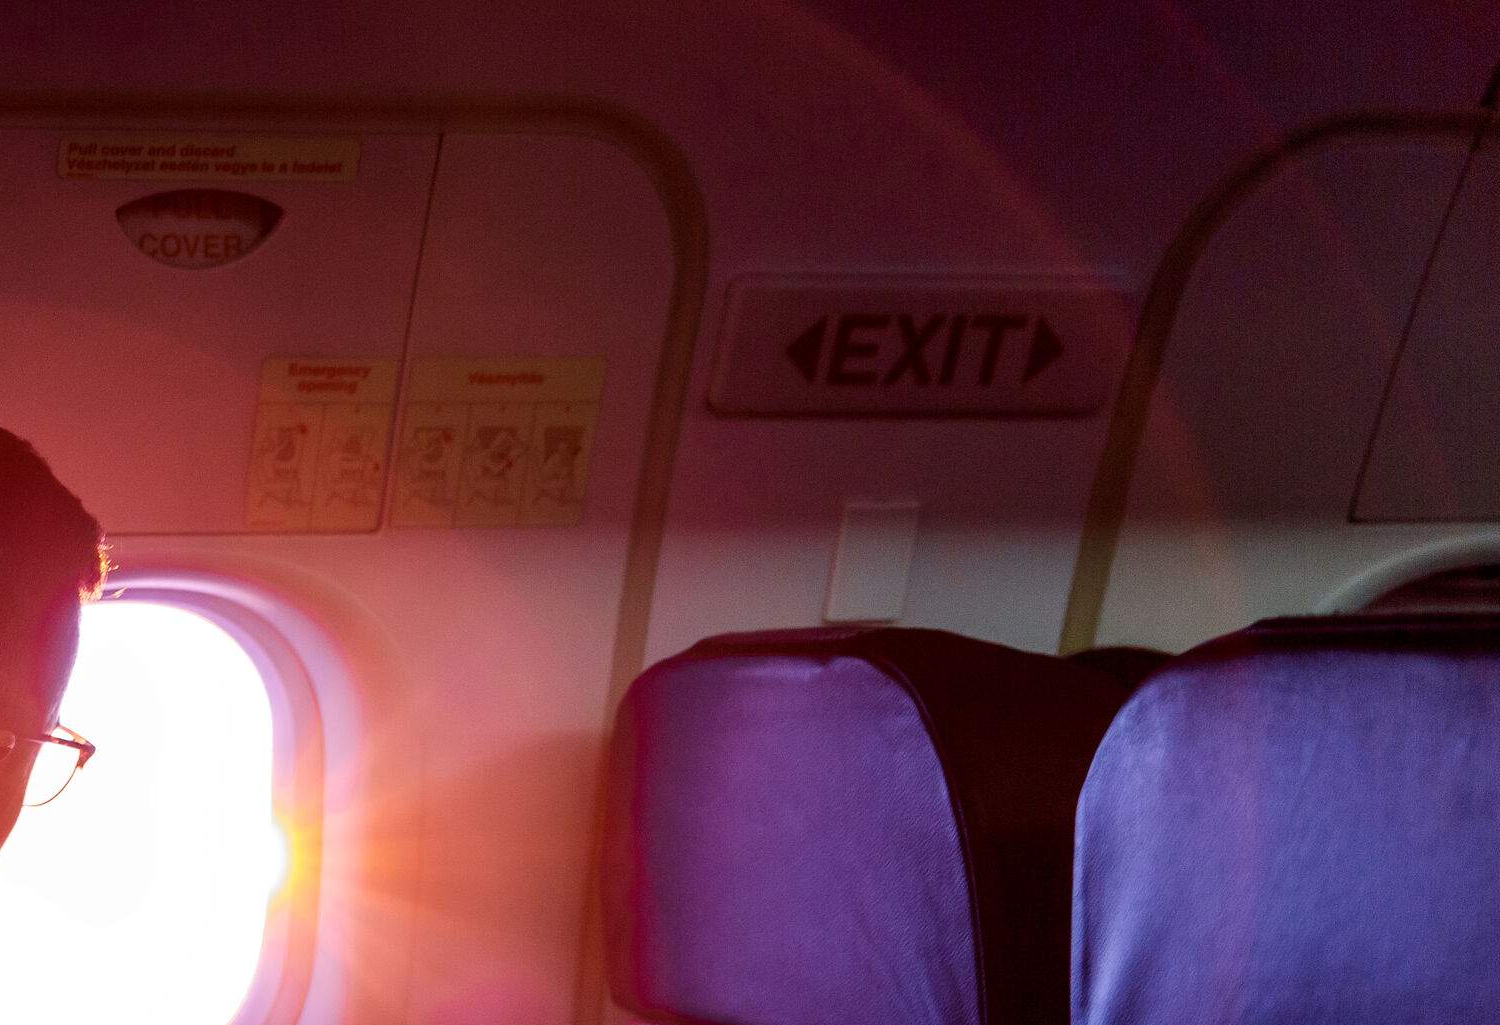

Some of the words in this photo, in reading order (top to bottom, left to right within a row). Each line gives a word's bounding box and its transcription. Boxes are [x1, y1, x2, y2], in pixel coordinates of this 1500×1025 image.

[68, 142, 97, 156] Pull
[101, 145, 143, 157] cover
[147, 143, 176, 157] and
[180, 143, 237, 157] discard
[138, 233, 242, 259] COVER
[825, 312, 1029, 386] EXIT
[287, 362, 373, 379] Emergency
[296, 380, 359, 395] opening
